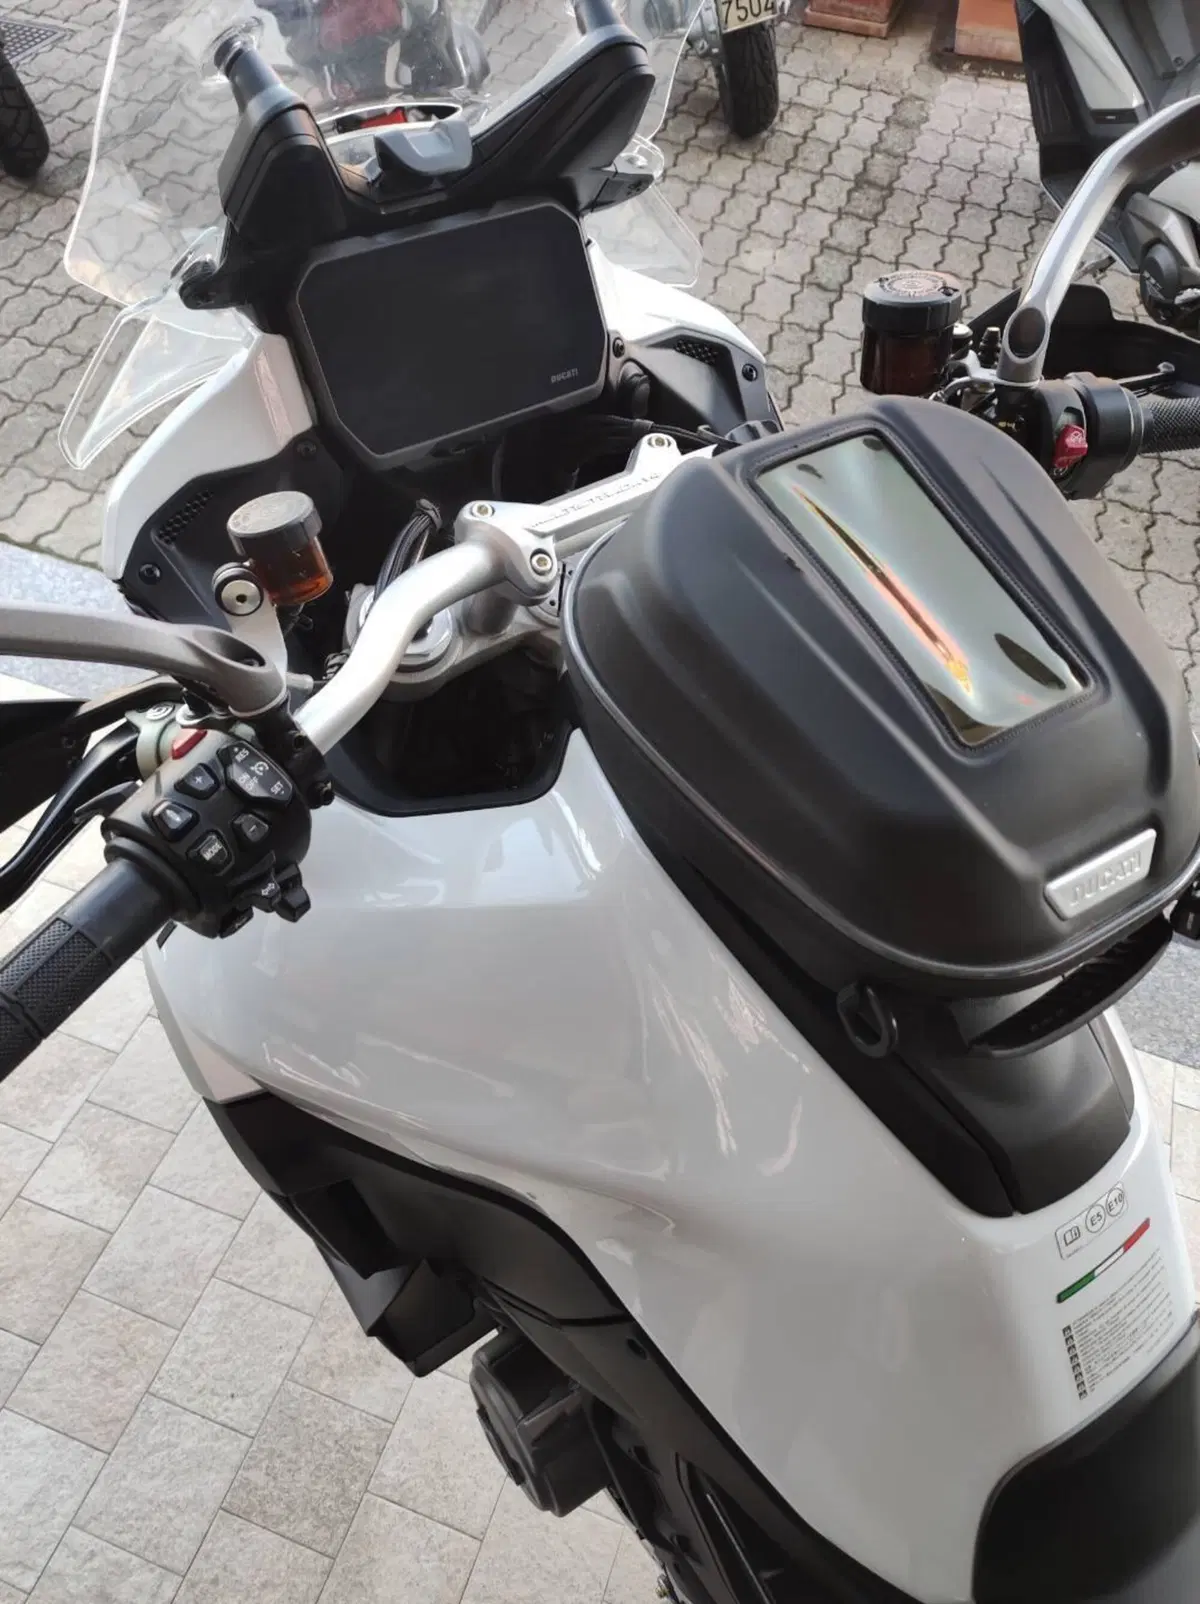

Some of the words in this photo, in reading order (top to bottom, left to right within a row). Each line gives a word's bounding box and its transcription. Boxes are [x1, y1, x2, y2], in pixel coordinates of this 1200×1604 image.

[722, 0, 775, 24] 7504
[551, 367, 578, 384] DUCATI
[235, 748, 250, 763] RES
[270, 781, 284, 795] SET
[203, 842, 223, 861] MODE
[1068, 849, 1141, 907] DUCATI
[1107, 1193, 1123, 1213] E10
[1090, 1211, 1103, 1227] E5
